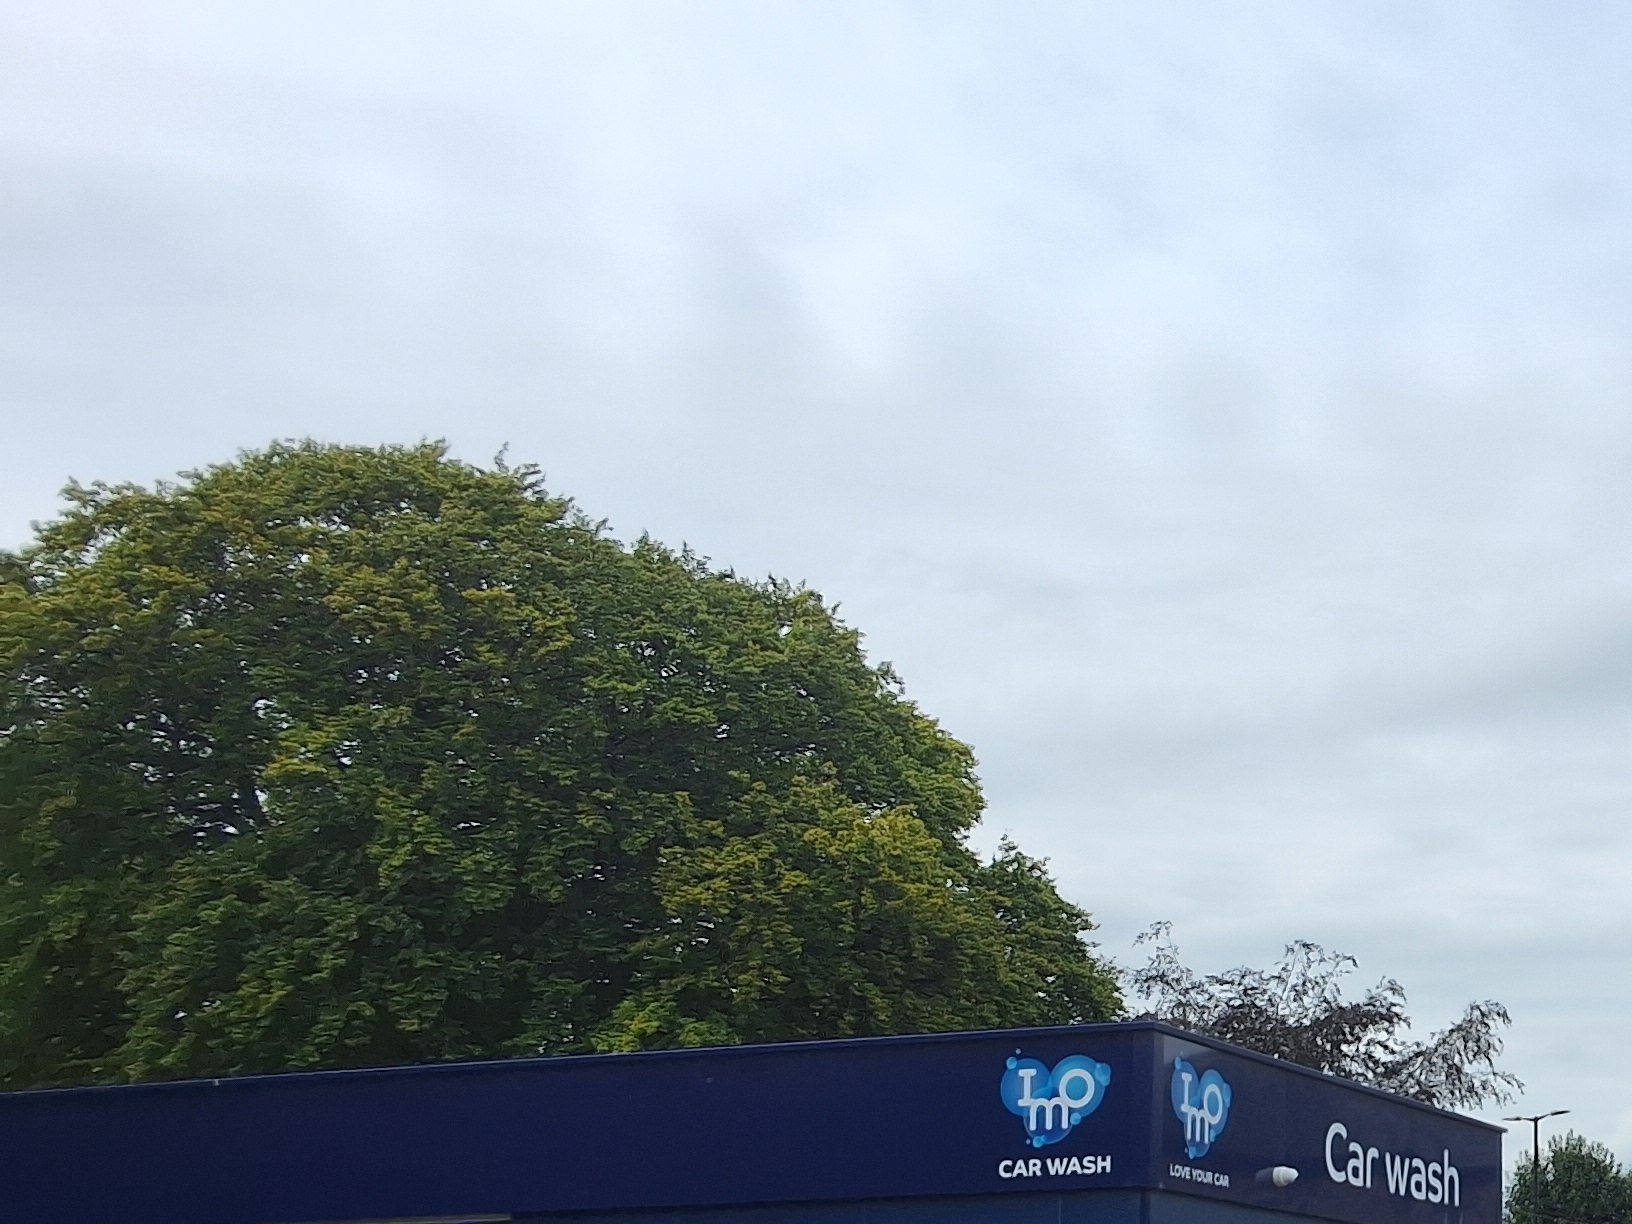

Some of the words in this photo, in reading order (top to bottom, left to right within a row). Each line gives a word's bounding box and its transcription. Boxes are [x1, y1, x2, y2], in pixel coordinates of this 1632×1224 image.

[998, 1158, 1042, 1178] CAR
[1046, 1155, 1112, 1176] WASH
[1169, 1163, 1191, 1181] LOVE
[1191, 1168, 1213, 1184] YOUR
[1214, 1172, 1230, 1187] CAR
[1325, 1122, 1379, 1189] Car
[1385, 1148, 1460, 1208] wash
